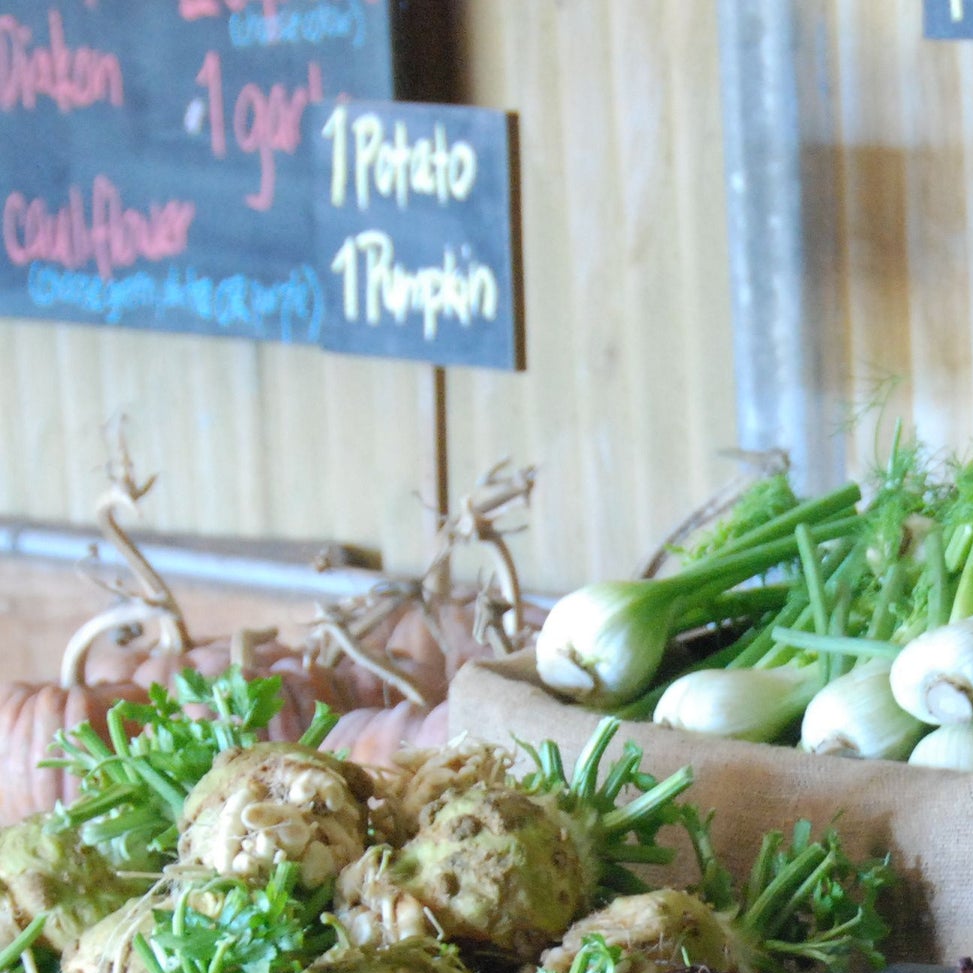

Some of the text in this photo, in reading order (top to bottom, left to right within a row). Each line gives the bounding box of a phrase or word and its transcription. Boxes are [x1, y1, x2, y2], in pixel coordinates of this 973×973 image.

[321, 105, 477, 211] 1 Potato
[330, 236, 359, 323] 1
[355, 229, 499, 342] Pumpkin
